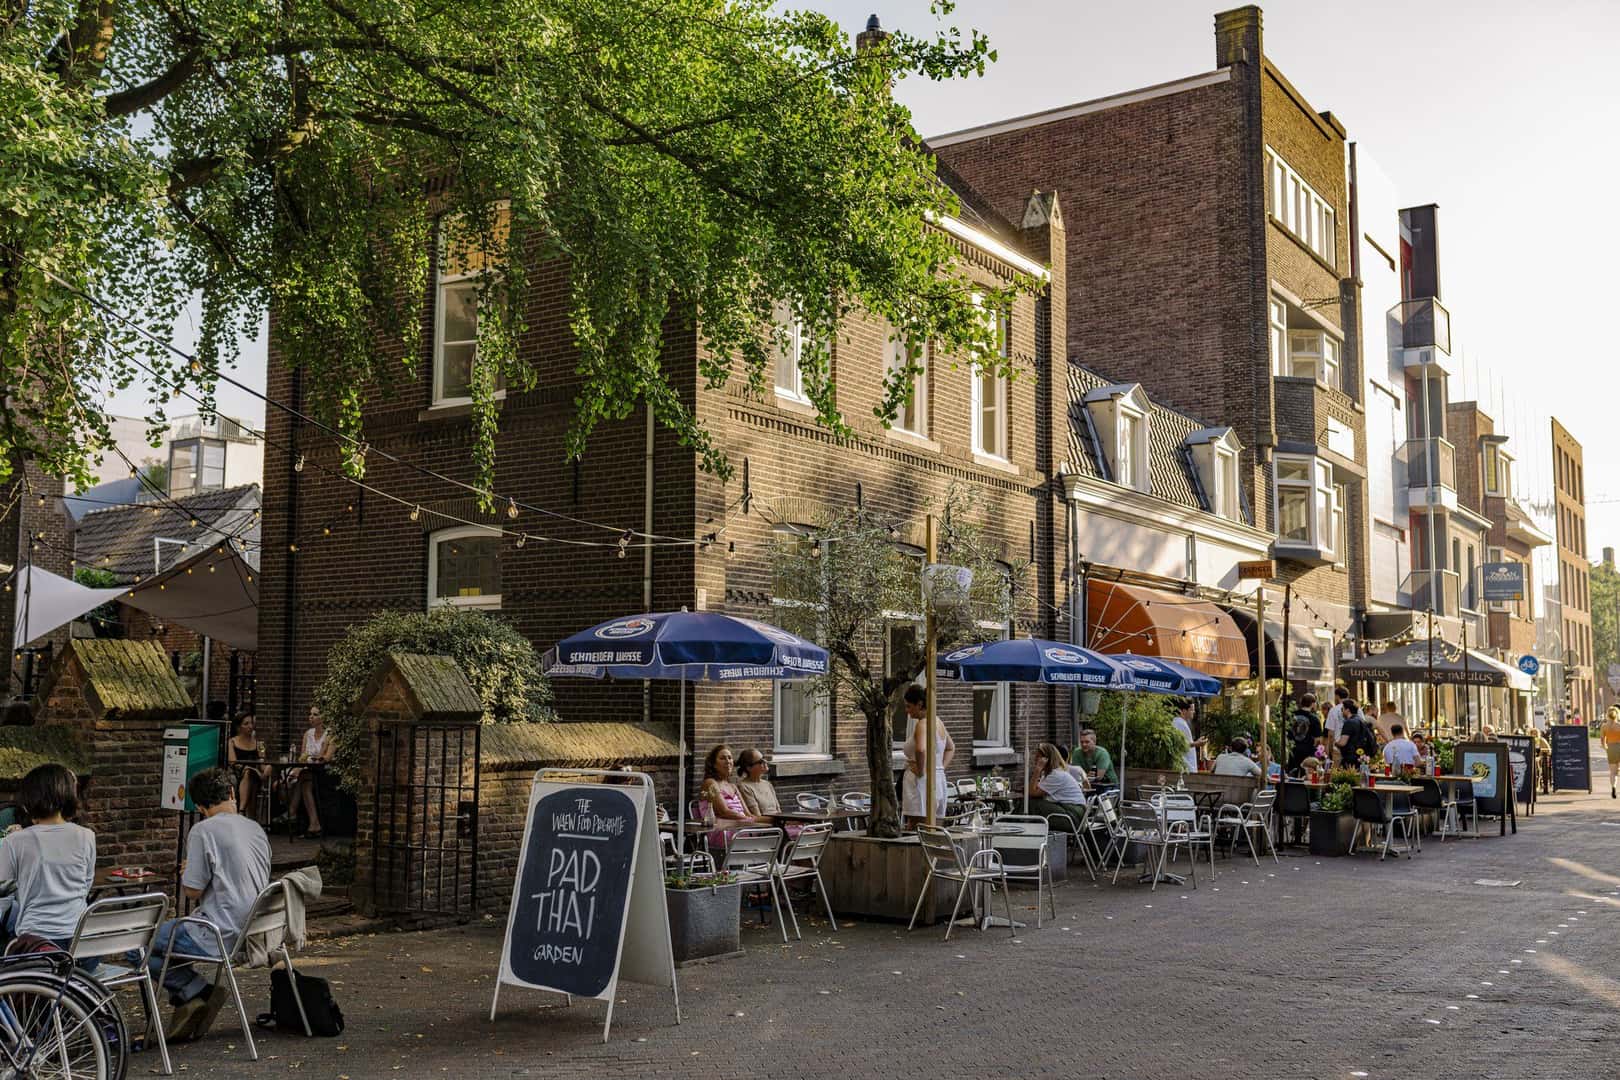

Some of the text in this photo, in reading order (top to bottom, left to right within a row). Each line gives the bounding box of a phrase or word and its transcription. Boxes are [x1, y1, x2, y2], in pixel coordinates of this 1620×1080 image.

[574, 798, 593, 814] THE
[547, 848, 601, 894] PAD
[533, 946, 584, 966] GARDEN
